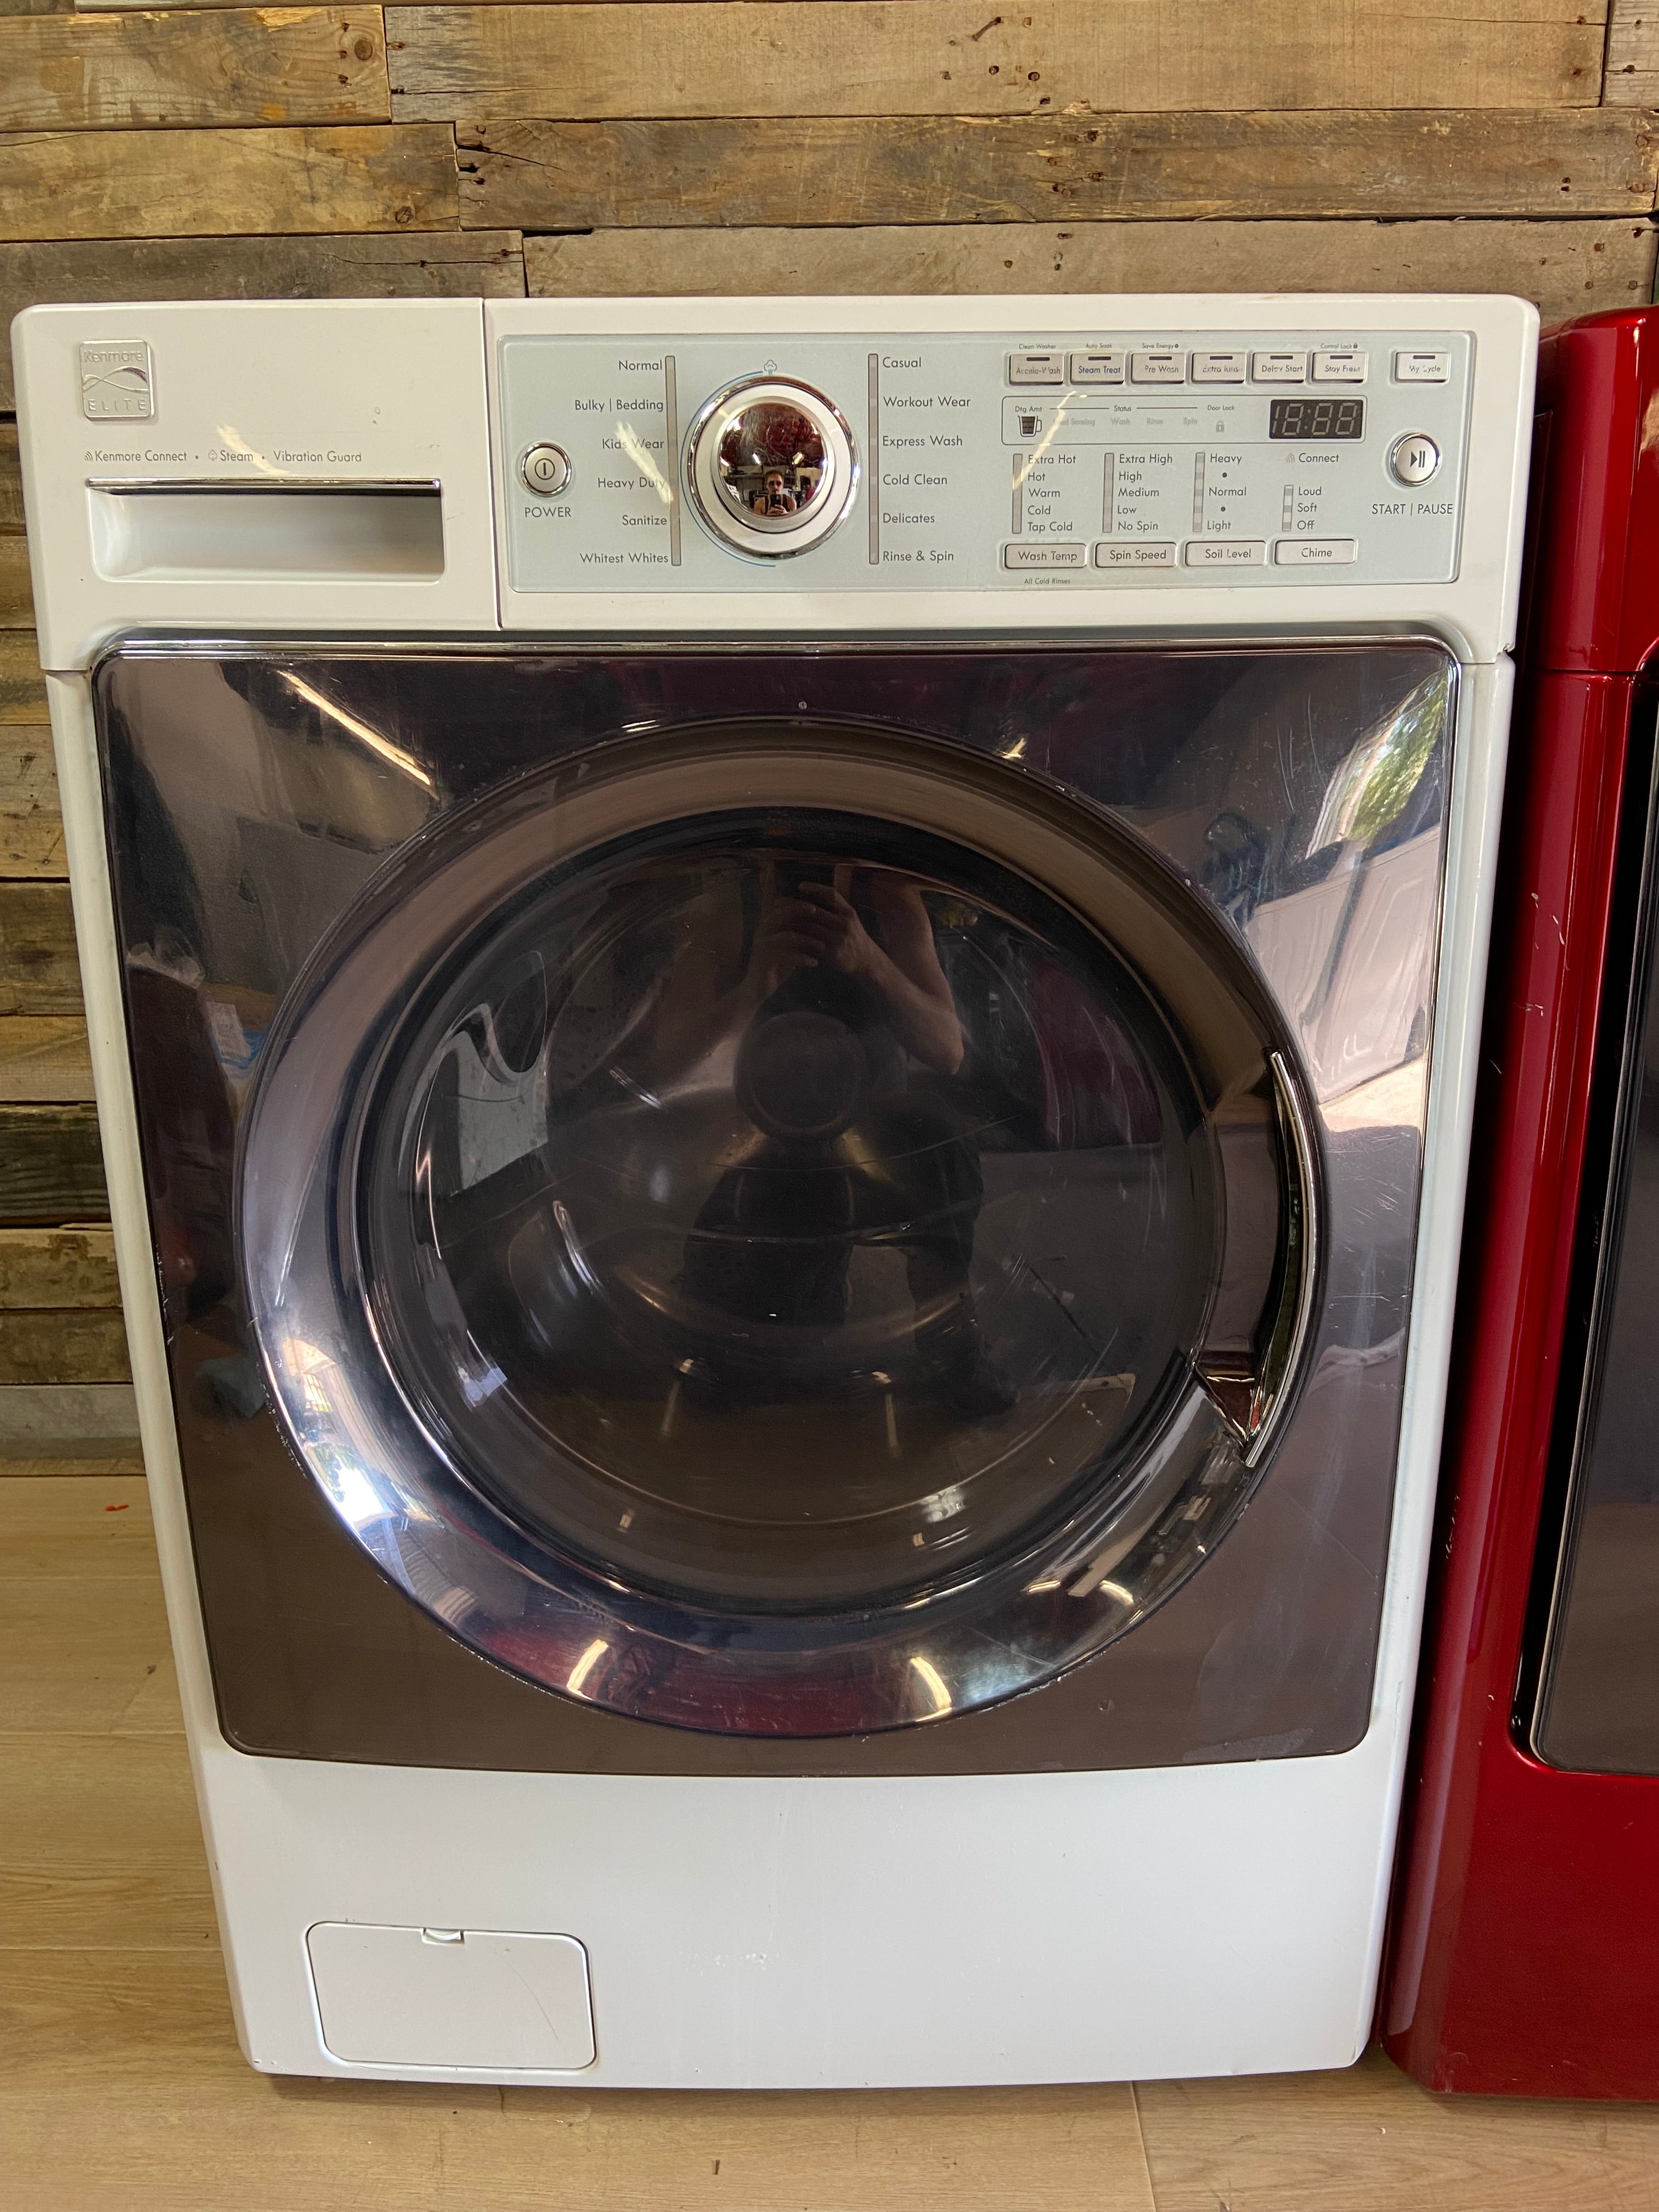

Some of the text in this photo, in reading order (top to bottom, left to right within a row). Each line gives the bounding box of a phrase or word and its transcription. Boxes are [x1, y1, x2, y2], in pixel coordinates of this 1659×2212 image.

[83, 350, 144, 363] Kenmore
[882, 356, 922, 368] Casual
[618, 359, 663, 371] Normal
[1079, 365, 1121, 374] Steam Treat
[1145, 365, 1155, 373] Pre
[1285, 364, 1303, 373] Start
[1324, 365, 1340, 373] Stay
[88, 399, 146, 411] ELITE
[575, 399, 605, 412] Bulky
[616, 399, 663, 412] Bedding
[883, 396, 971, 408] Workout Wear
[1184, 417, 1198, 426] Spin
[602, 438, 664, 449] Kids Wear
[882, 435, 963, 449] Express Wash
[95, 450, 187, 461] Kenmore Connect
[220, 450, 253, 461] Steam
[273, 450, 362, 462] Vibration Guard
[1028, 454, 1076, 464] Extra Hot
[1119, 453, 1173, 465] Extra High
[1210, 453, 1242, 465] Heavy
[1299, 453, 1339, 463] Connect
[883, 474, 947, 485] Cold Clean
[1028, 471, 1046, 482] Hot
[1119, 471, 1142, 483] High
[597, 477, 665, 490] Heavy Duty
[1028, 488, 1060, 498] Warm
[1118, 488, 1159, 497] Medium
[1209, 487, 1246, 496] Normal
[1298, 486, 1322, 496] Loud
[524, 507, 572, 518] POWER
[1028, 505, 1051, 515] Cold
[1117, 505, 1137, 514] Low
[1297, 503, 1317, 512] Soft
[1372, 504, 1406, 515] START
[1417, 504, 1453, 514] PAUSE
[622, 515, 667, 526] Sanitize
[882, 512, 935, 523] Delicates
[1028, 521, 1073, 533] Tap Cold
[1118, 521, 1158, 533] No Spin
[1207, 521, 1231, 532] Light
[1297, 520, 1314, 530] Off
[579, 552, 669, 563] Whitest Whites
[882, 550, 954, 563] Rinse & Spin
[1018, 551, 1077, 563] Wash Temp
[1109, 549, 1166, 562] Spin Speed
[1205, 548, 1251, 558] Soil Level
[1301, 548, 1333, 557] Chime
